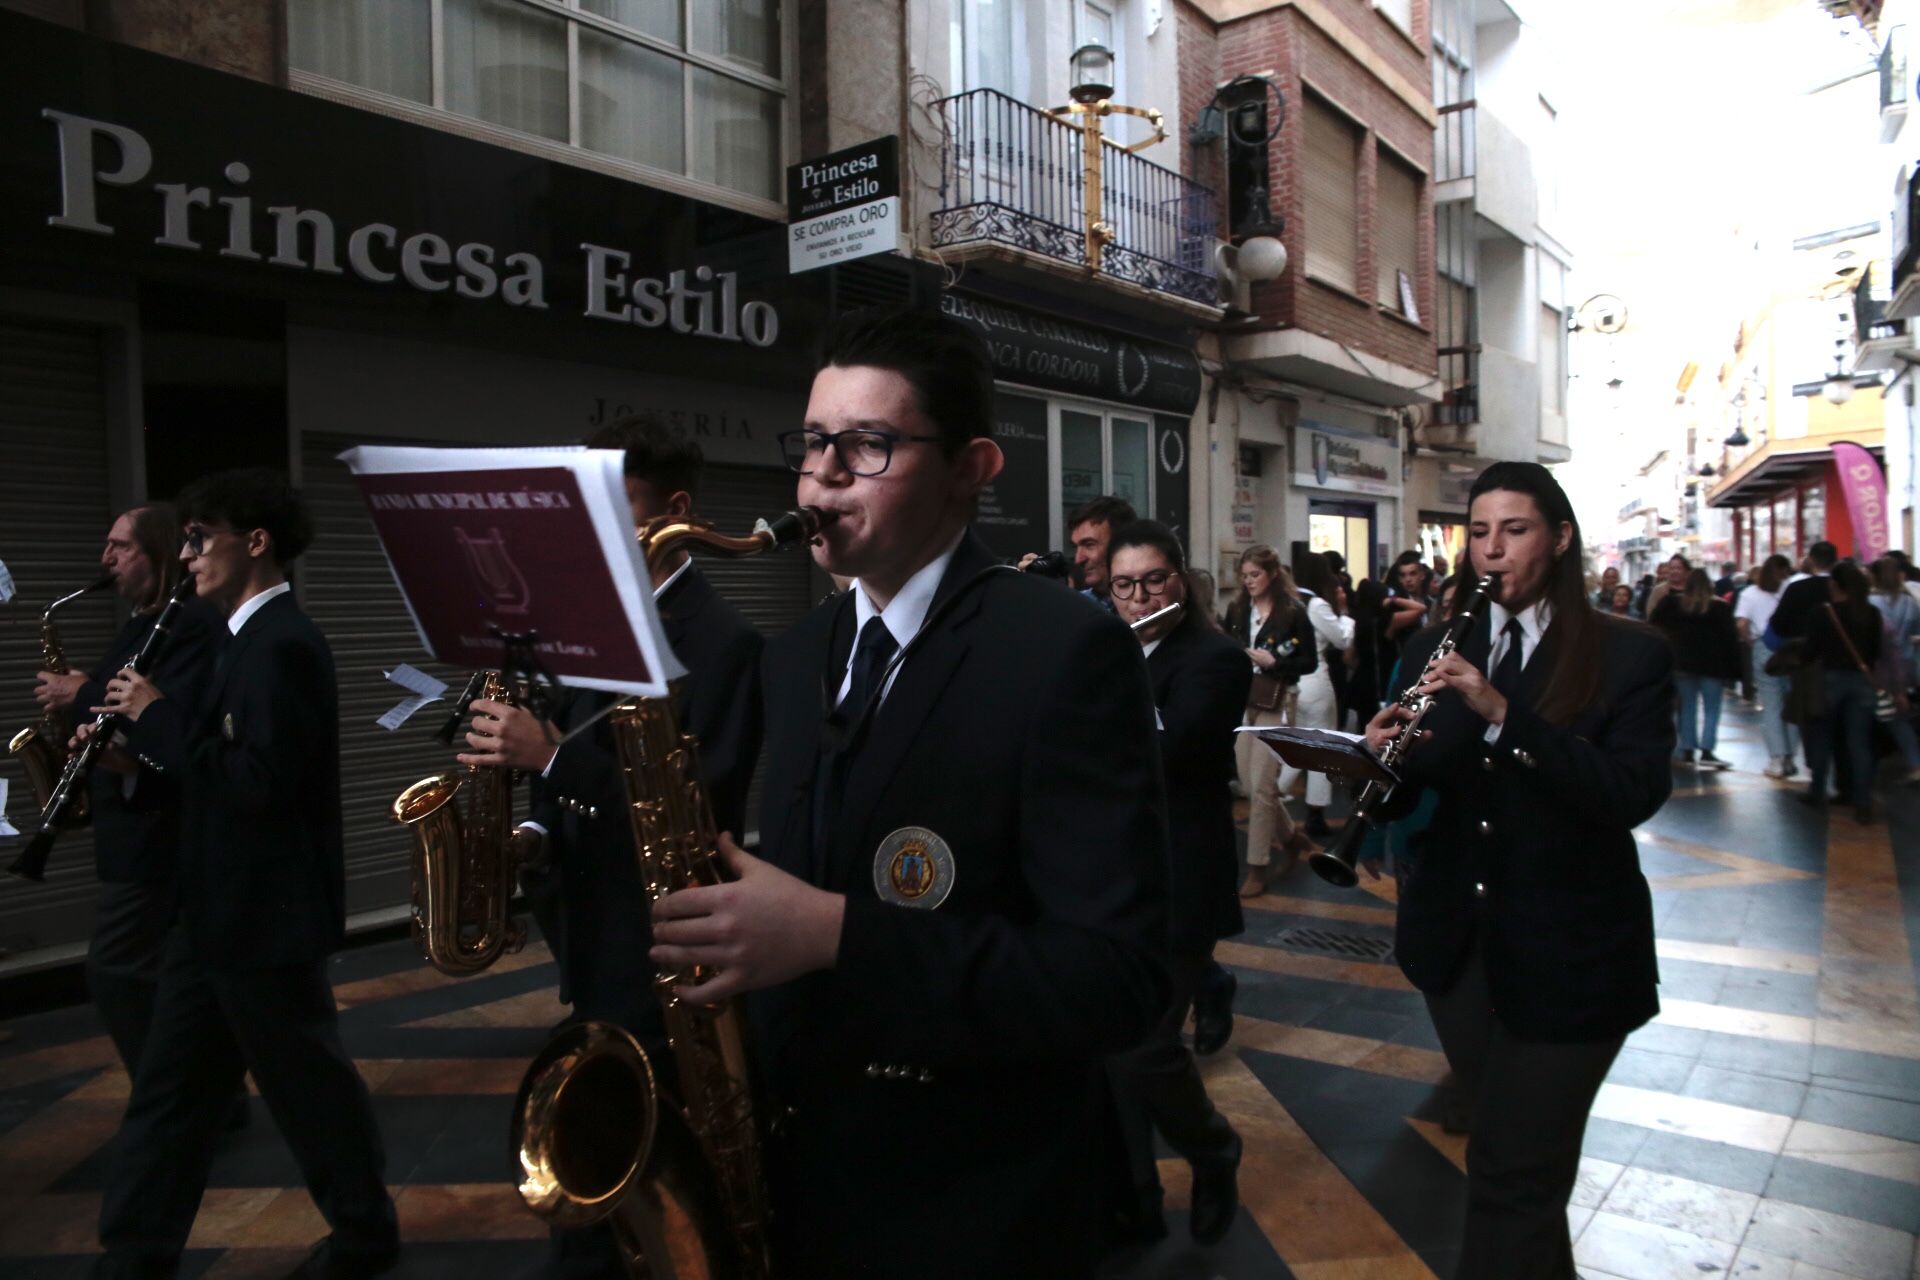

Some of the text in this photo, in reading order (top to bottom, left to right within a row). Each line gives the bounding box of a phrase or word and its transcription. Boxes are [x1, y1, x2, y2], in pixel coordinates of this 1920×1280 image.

[800, 154, 879, 189] Princesa
[833, 177, 880, 204] Estilo
[41, 107, 779, 347] Princesa Estilo
[793, 203, 888, 241] SE COMPRA ORO
[941, 294, 1028, 334] EZEQUIEL
[589, 398, 752, 440] JORÍA
